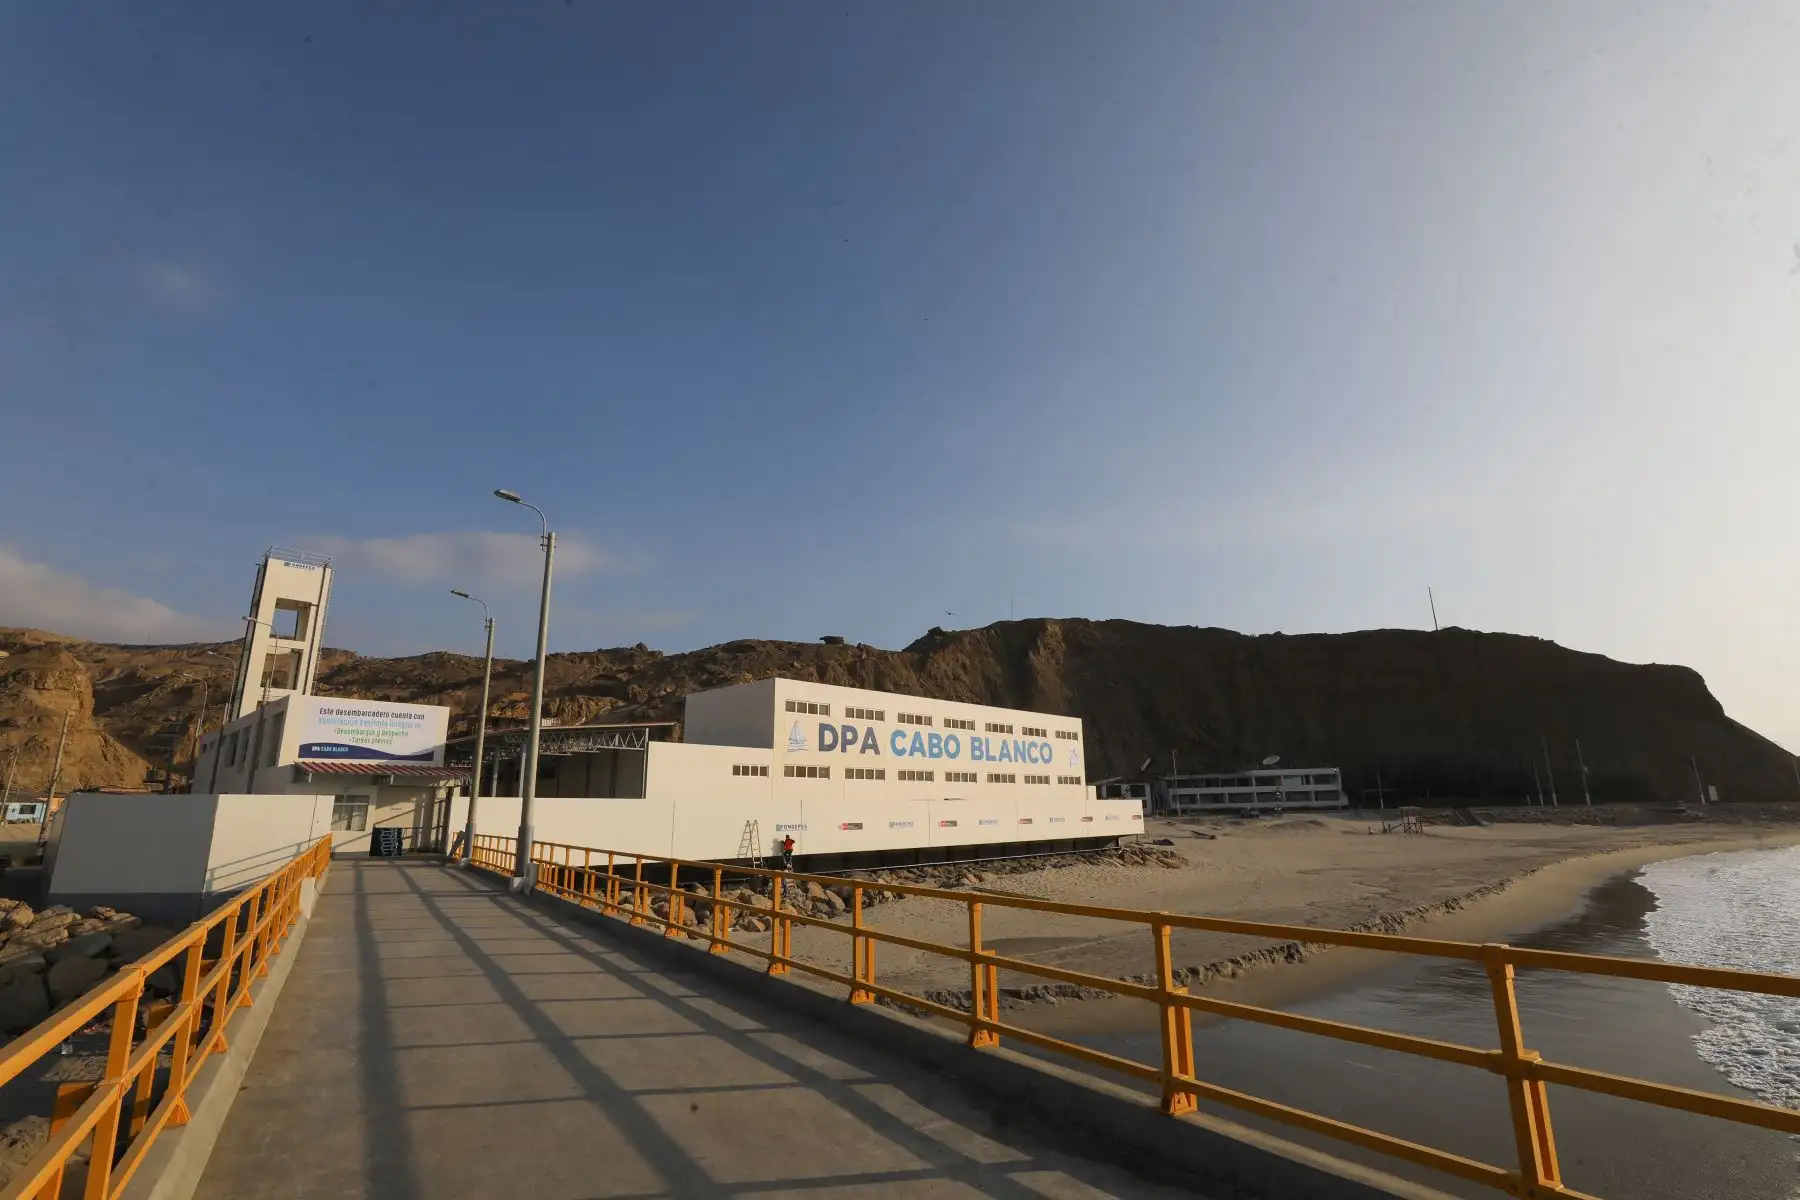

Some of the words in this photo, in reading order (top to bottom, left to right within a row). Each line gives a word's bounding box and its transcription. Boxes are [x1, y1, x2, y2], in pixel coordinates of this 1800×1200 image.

[319, 707, 334, 715] Este
[335, 708, 390, 718] desembarcadero
[818, 722, 881, 755] DPA
[890, 729, 961, 760] CABO
[970, 736, 1053, 764] BLANCO
